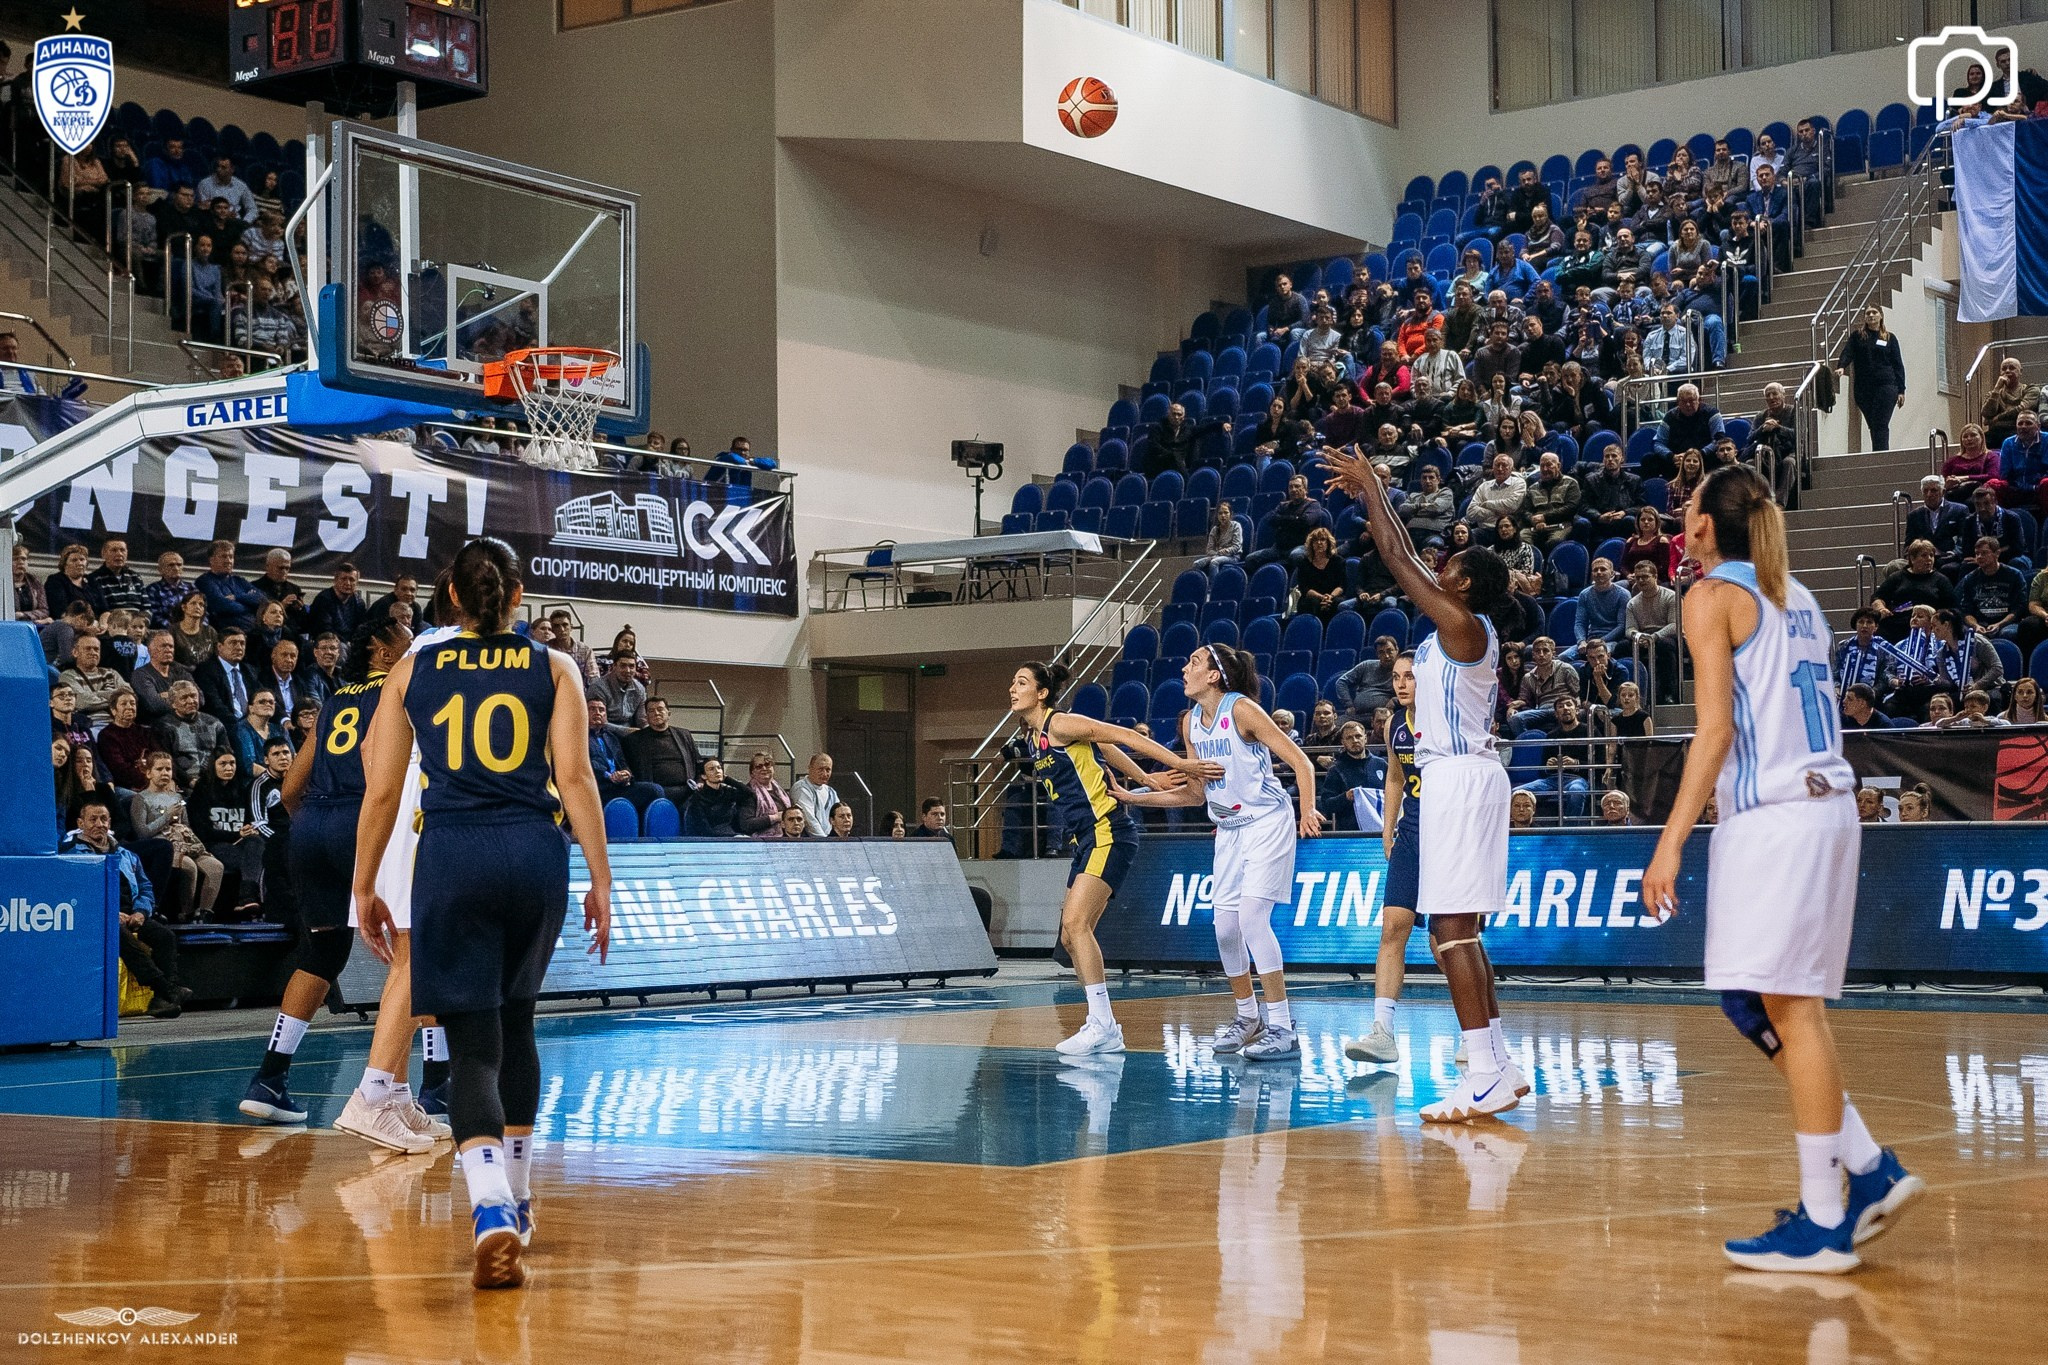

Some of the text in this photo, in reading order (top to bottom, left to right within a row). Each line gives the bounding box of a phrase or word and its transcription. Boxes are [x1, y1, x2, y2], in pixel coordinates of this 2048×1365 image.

[235, 67, 259, 82] MegaS
[367, 50, 396, 65] MegaS
[530, 556, 787, 597] СПОРТИВНО-КОНЦЕРТНЫЙ КОМПЛЕКС
[436, 647, 531, 670] PLUM
[326, 706, 360, 755] 8
[432, 692, 530, 773] 10
[698, 876, 898, 942] CHARLES
[1294, 871, 1385, 927] TIN
[1485, 868, 1673, 928] ARLE
